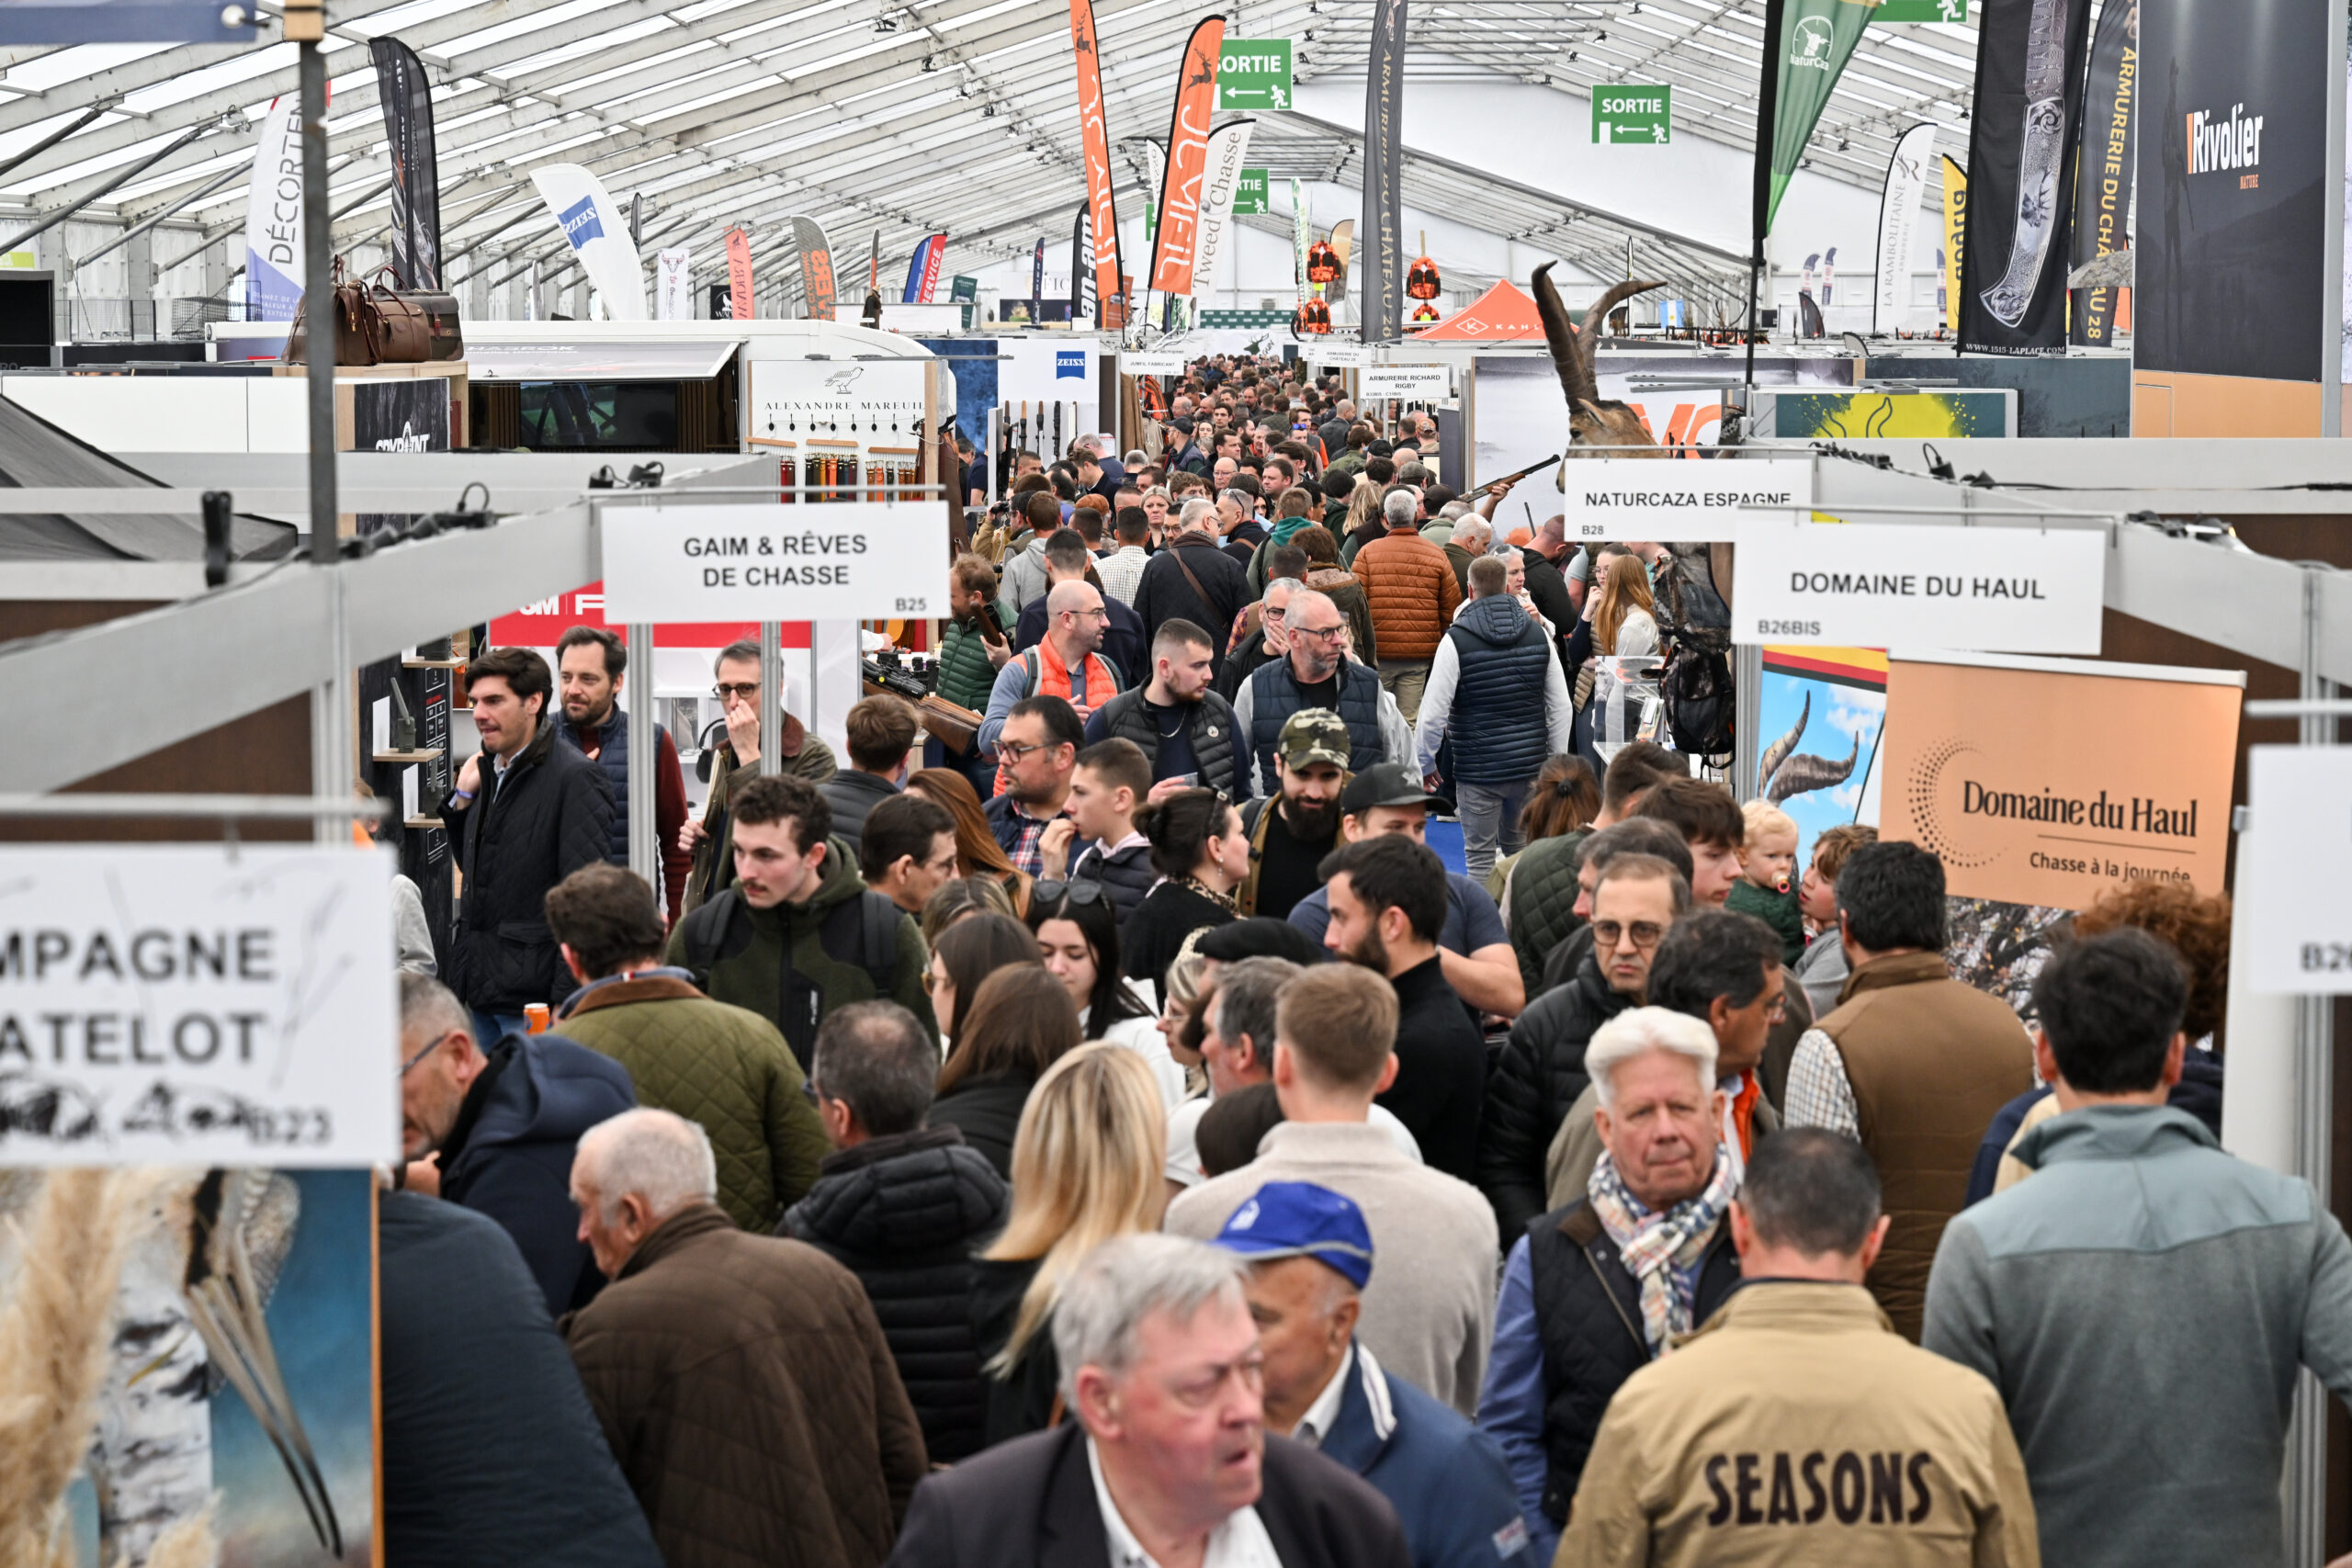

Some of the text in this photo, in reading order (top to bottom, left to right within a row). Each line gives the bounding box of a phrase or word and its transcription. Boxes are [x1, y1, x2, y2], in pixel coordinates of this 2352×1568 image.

[1216, 52, 1283, 74] SORTIE
[1380, 49, 1394, 173] ARMURERIE
[1601, 97, 1662, 115] SORTIE
[2191, 103, 2264, 175] Rivolier
[1236, 178, 1262, 191] RTIE
[1382, 173, 1390, 206] DU
[2086, 45, 2136, 340] ARMURERIE DU CHÂAU 28
[2239, 174, 2259, 190] NATURE
[1193, 131, 1241, 288] Tweed Chasse
[1883, 185, 1906, 307] LA RAMBOLITAINE
[922, 247, 942, 304] SERVICE
[1381, 313, 1393, 339] 28
[1057, 358, 1085, 367] ZEISS
[764, 401, 925, 410] ALEXANDRE MAREUIL
[1585, 491, 1792, 508] NATURCAZA ESPAGNE
[1581, 524, 1605, 536] B28
[684, 530, 867, 558] GAIM & RÊVES
[703, 565, 850, 588] DE CHASSE
[1790, 571, 2046, 600] DOMAINE DU HAUL
[895, 597, 927, 613] B25
[1757, 618, 1821, 637] B26BIS
[1962, 780, 2198, 838] Domaine du Haul
[2029, 851, 2190, 883] Chasse à la journée
[1705, 1450, 1932, 1529] SEASONS
